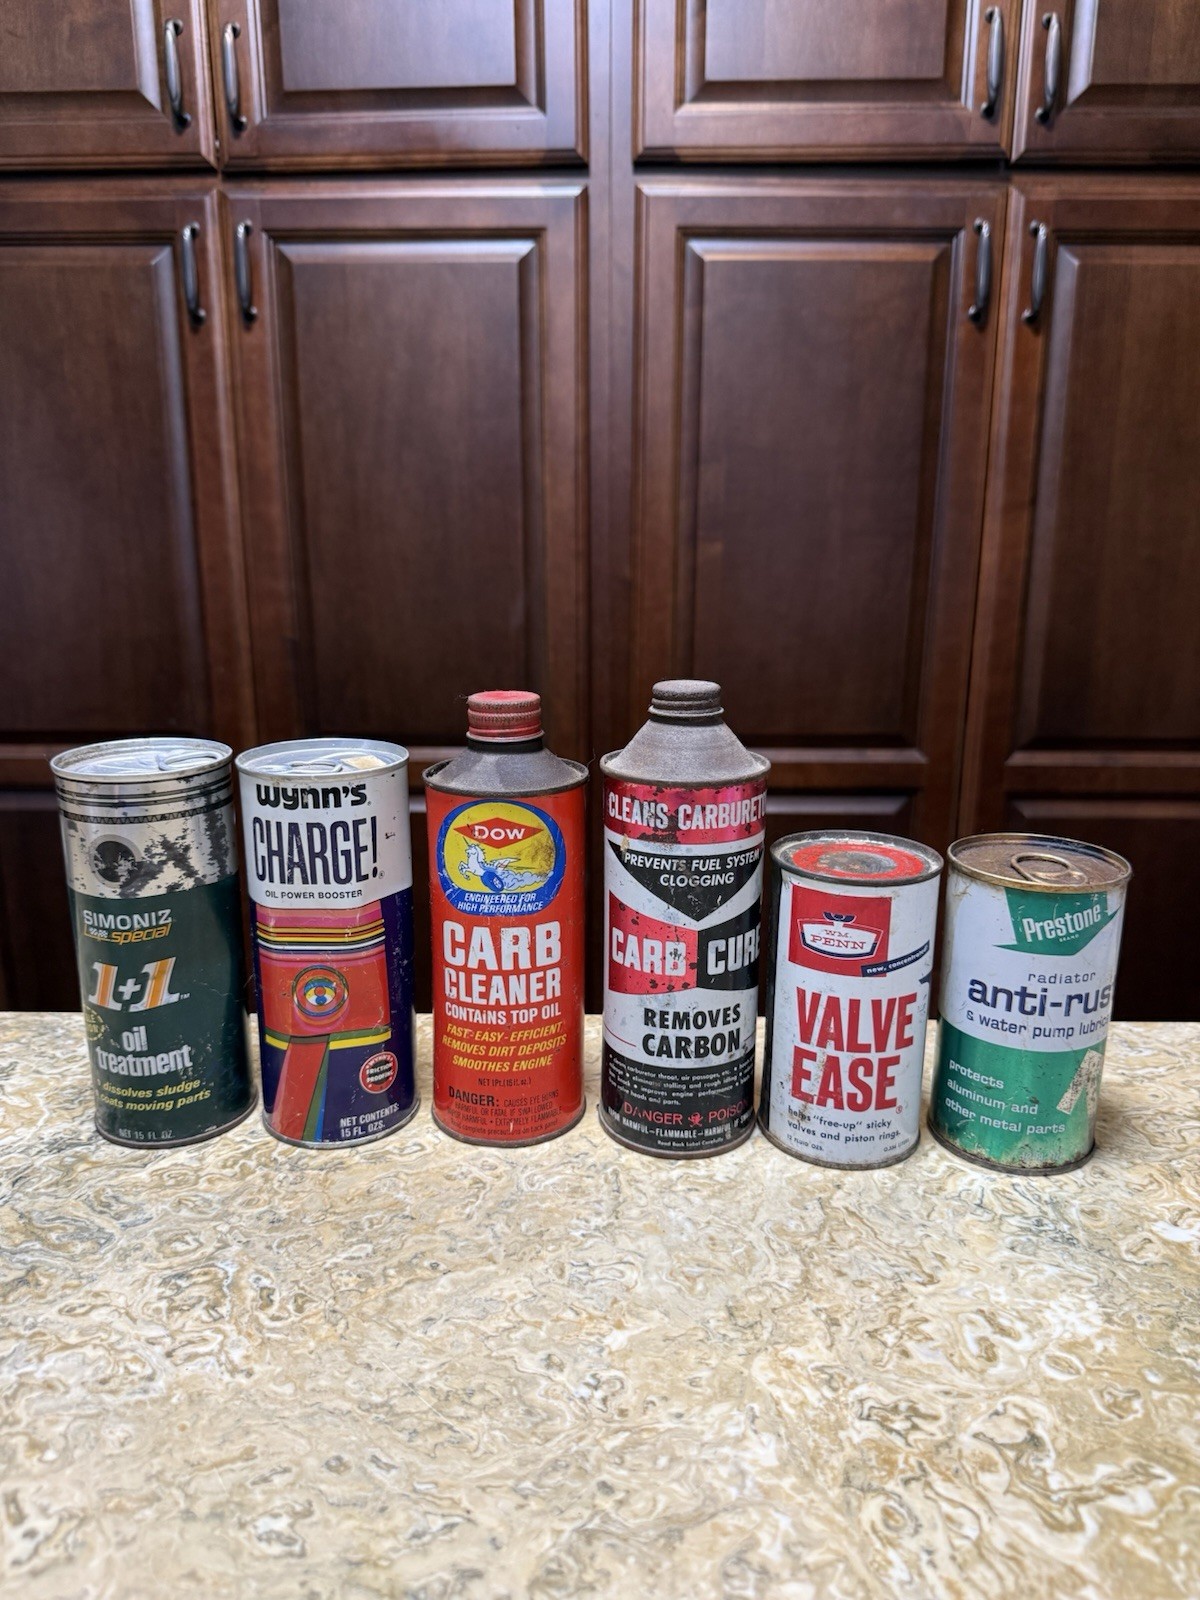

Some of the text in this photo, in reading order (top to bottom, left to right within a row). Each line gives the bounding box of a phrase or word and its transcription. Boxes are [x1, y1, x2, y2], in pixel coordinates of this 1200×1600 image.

[608, 792, 668, 829] CLEANS
[474, 826, 525, 839] DOW
[253, 816, 378, 885] CHARGE!
[624, 849, 760, 871] PREVENTS FUEL SYSTEM
[660, 872, 734, 887] CLOGGING
[265, 890, 278, 898] OIL
[318, 890, 362, 899] BOOSTER
[465, 893, 536, 904] ENGINEERED FOR
[458, 901, 543, 914] HIGH PERFORMANCE
[83, 909, 172, 930] SIMONIZ
[1022, 904, 1100, 942] Prestone
[111, 922, 172, 945] special
[811, 934, 866, 950] PENN
[1059, 934, 1079, 942] BRAND
[443, 920, 561, 970] CARB
[612, 927, 686, 976] CARB
[444, 966, 561, 1006] CLEANER
[1028, 972, 1096, 984] radiator
[968, 978, 1112, 1017] anti-rus
[510, 1008, 538, 1023] TOP
[542, 1002, 561, 1020] OIL
[644, 1003, 740, 1030] REMOVES
[796, 986, 917, 1053] VALVE
[510, 1021, 563, 1042] EFFICIENT
[979, 1014, 1026, 1034] water
[1033, 1025, 1074, 1039] pump
[122, 1026, 147, 1051] oil
[442, 1034, 567, 1057] REMOVES DIRT DEPOSITS
[642, 1028, 740, 1058] CARBON
[96, 1044, 193, 1077] treatment
[452, 1054, 553, 1072] SMOOTHES ENGINE
[627, 1066, 656, 1077] carburetor
[478, 1078, 490, 1086] NET
[791, 1045, 900, 1113] EASE
[949, 1059, 1004, 1089] protects
[100, 1089, 211, 1111] coats moving parts
[102, 1080, 200, 1098] dissolves sludge
[448, 1086, 499, 1107] DANGER:
[504, 1098, 528, 1107] CAUSES
[530, 1095, 540, 1105] EYE
[630, 1091, 647, 1100] heads
[641, 1085, 667, 1096] improves
[698, 1085, 733, 1097] performance
[947, 1079, 1038, 1115] aluminum and
[340, 1117, 357, 1128] NET
[624, 1102, 683, 1125] DANGER
[708, 1100, 744, 1123] POISO
[788, 1105, 811, 1121] helps
[866, 1119, 892, 1129] sticky
[945, 1097, 1066, 1135] other metal parts
[119, 1128, 131, 1138] NET
[135, 1131, 144, 1139] 15
[340, 1121, 385, 1138] 15 FL. OZS.
[788, 1120, 901, 1144] valves and piston rings.
[794, 1137, 809, 1147] FLUID
